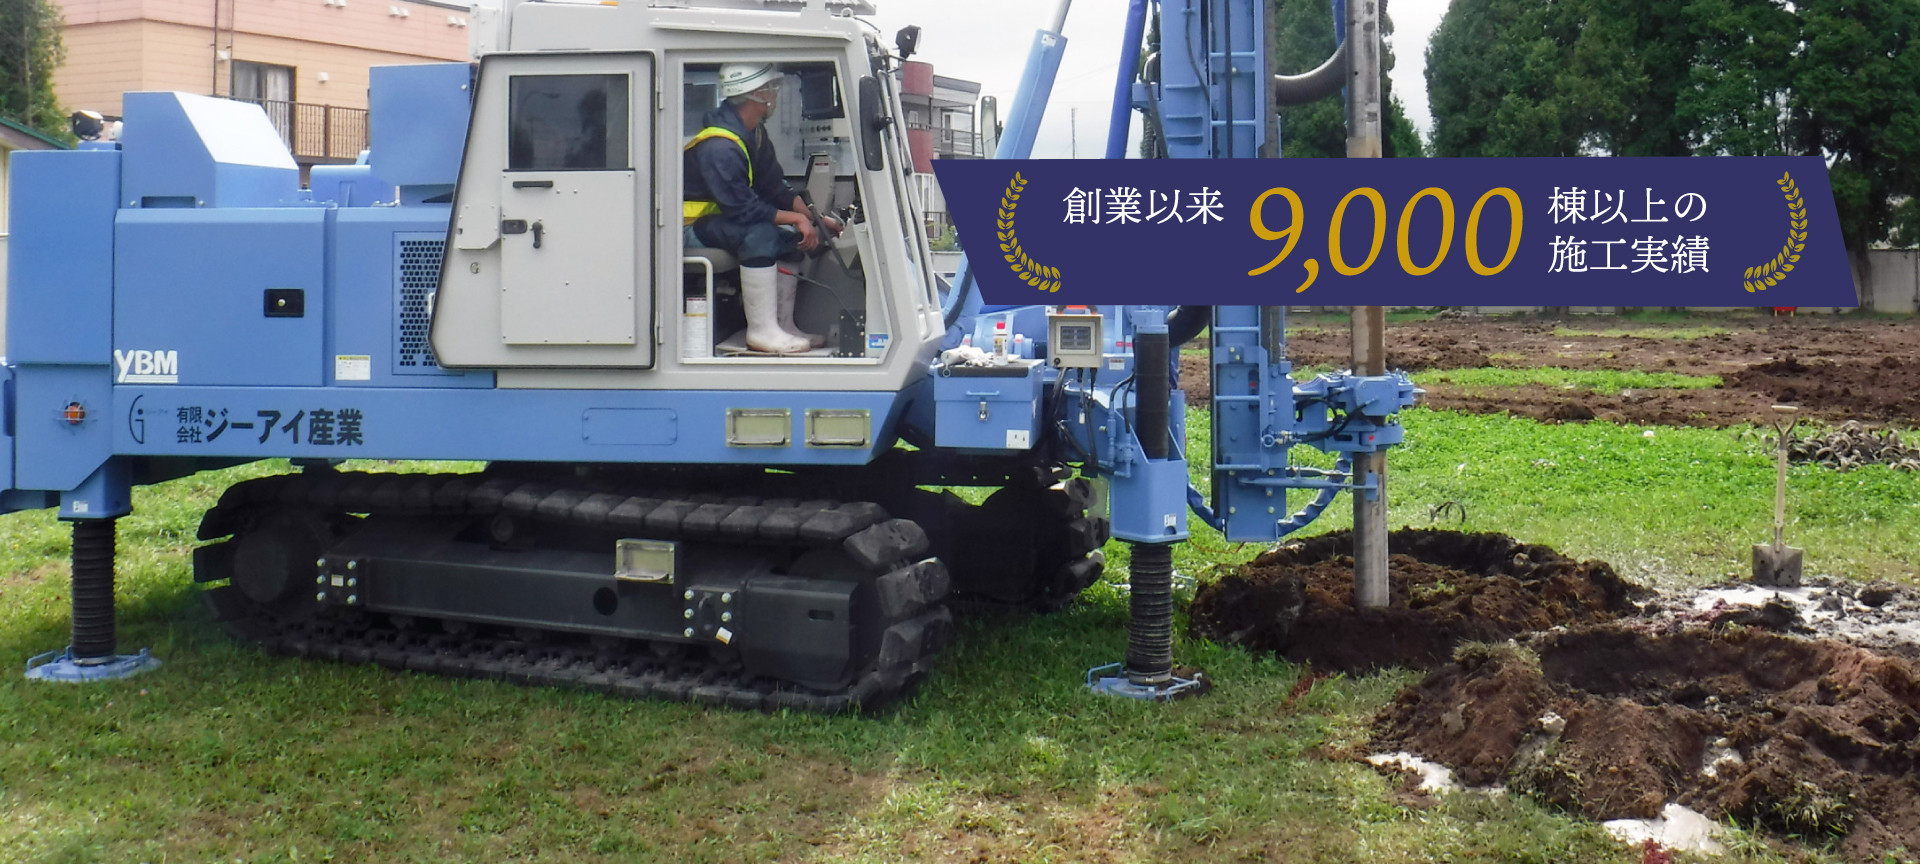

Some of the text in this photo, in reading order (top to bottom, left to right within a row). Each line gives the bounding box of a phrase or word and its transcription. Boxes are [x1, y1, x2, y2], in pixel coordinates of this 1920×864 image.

[114, 349, 178, 383] YBM
[177, 406, 202, 423] 有限
[205, 408, 364, 446] ジーアイ産業
[177, 426, 202, 443] 会社
